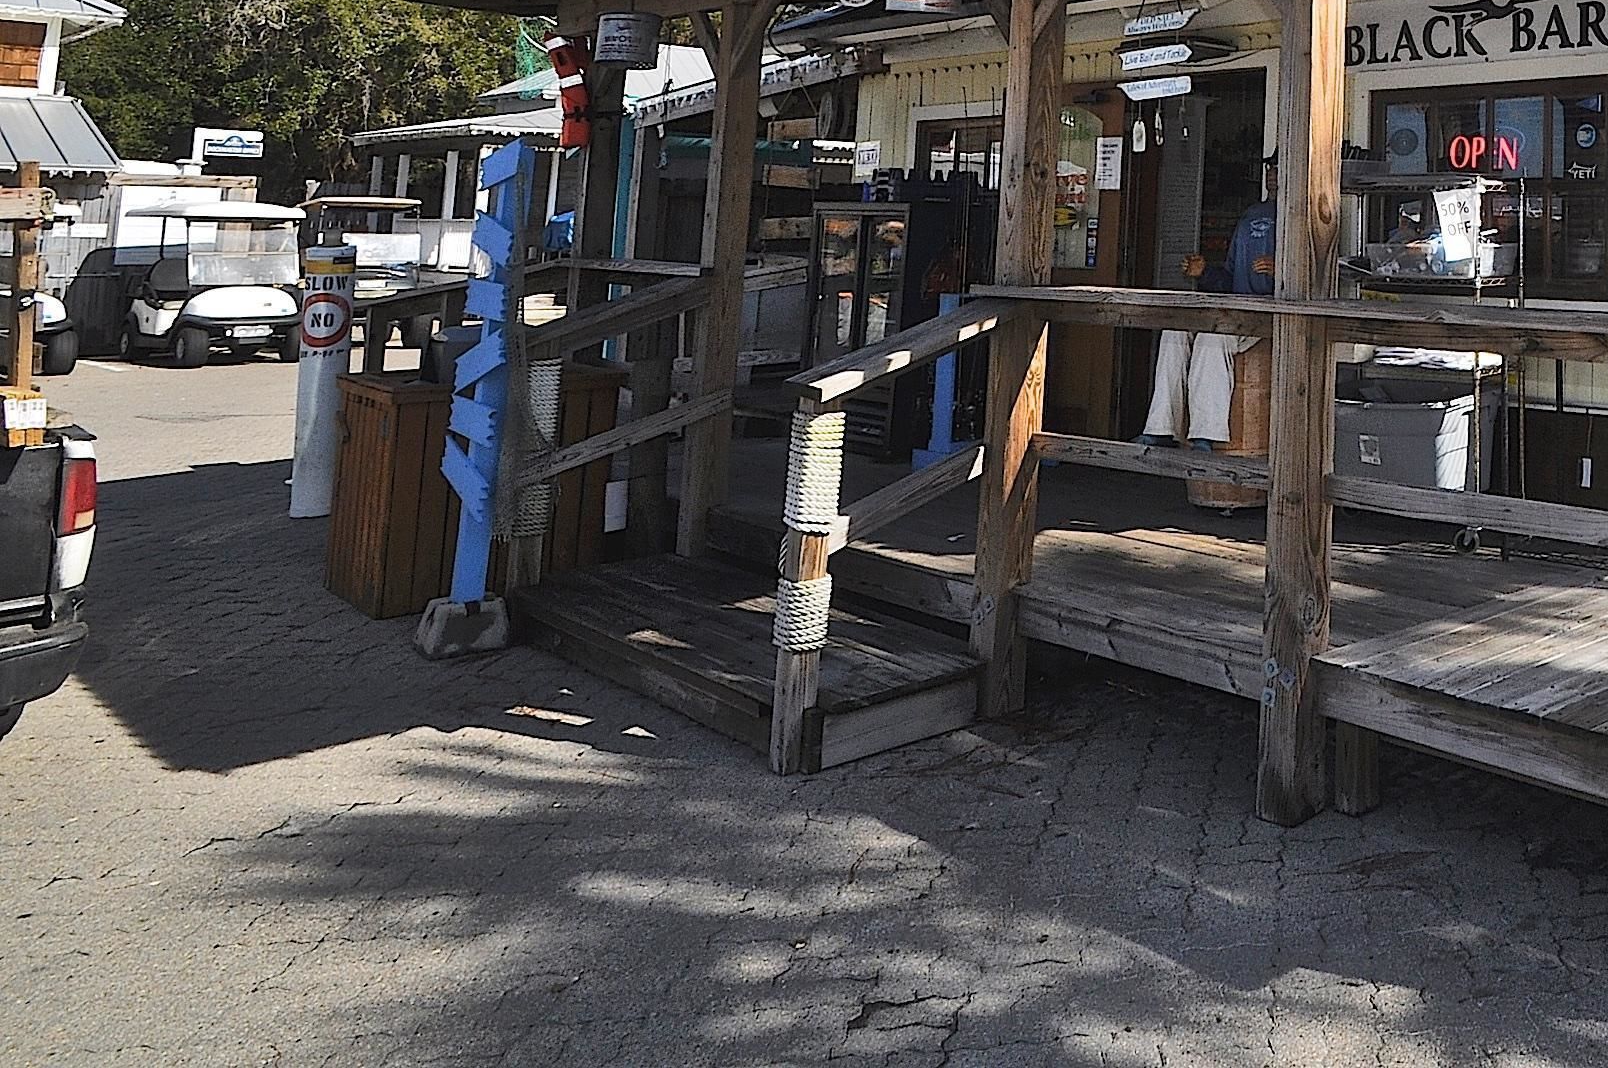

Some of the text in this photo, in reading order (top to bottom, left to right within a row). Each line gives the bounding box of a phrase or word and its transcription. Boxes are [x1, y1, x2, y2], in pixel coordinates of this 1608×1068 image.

[1345, 12, 1488, 67] BLACK
[1125, 55, 1138, 66] Live
[1139, 52, 1153, 63] Bait
[1154, 51, 1166, 61] and
[1573, 169, 1596, 180] YETI
[1440, 200, 1470, 218] 50%
[1447, 220, 1472, 237] OFF
[304, 275, 349, 291] SLOW
[310, 312, 335, 328] NO
